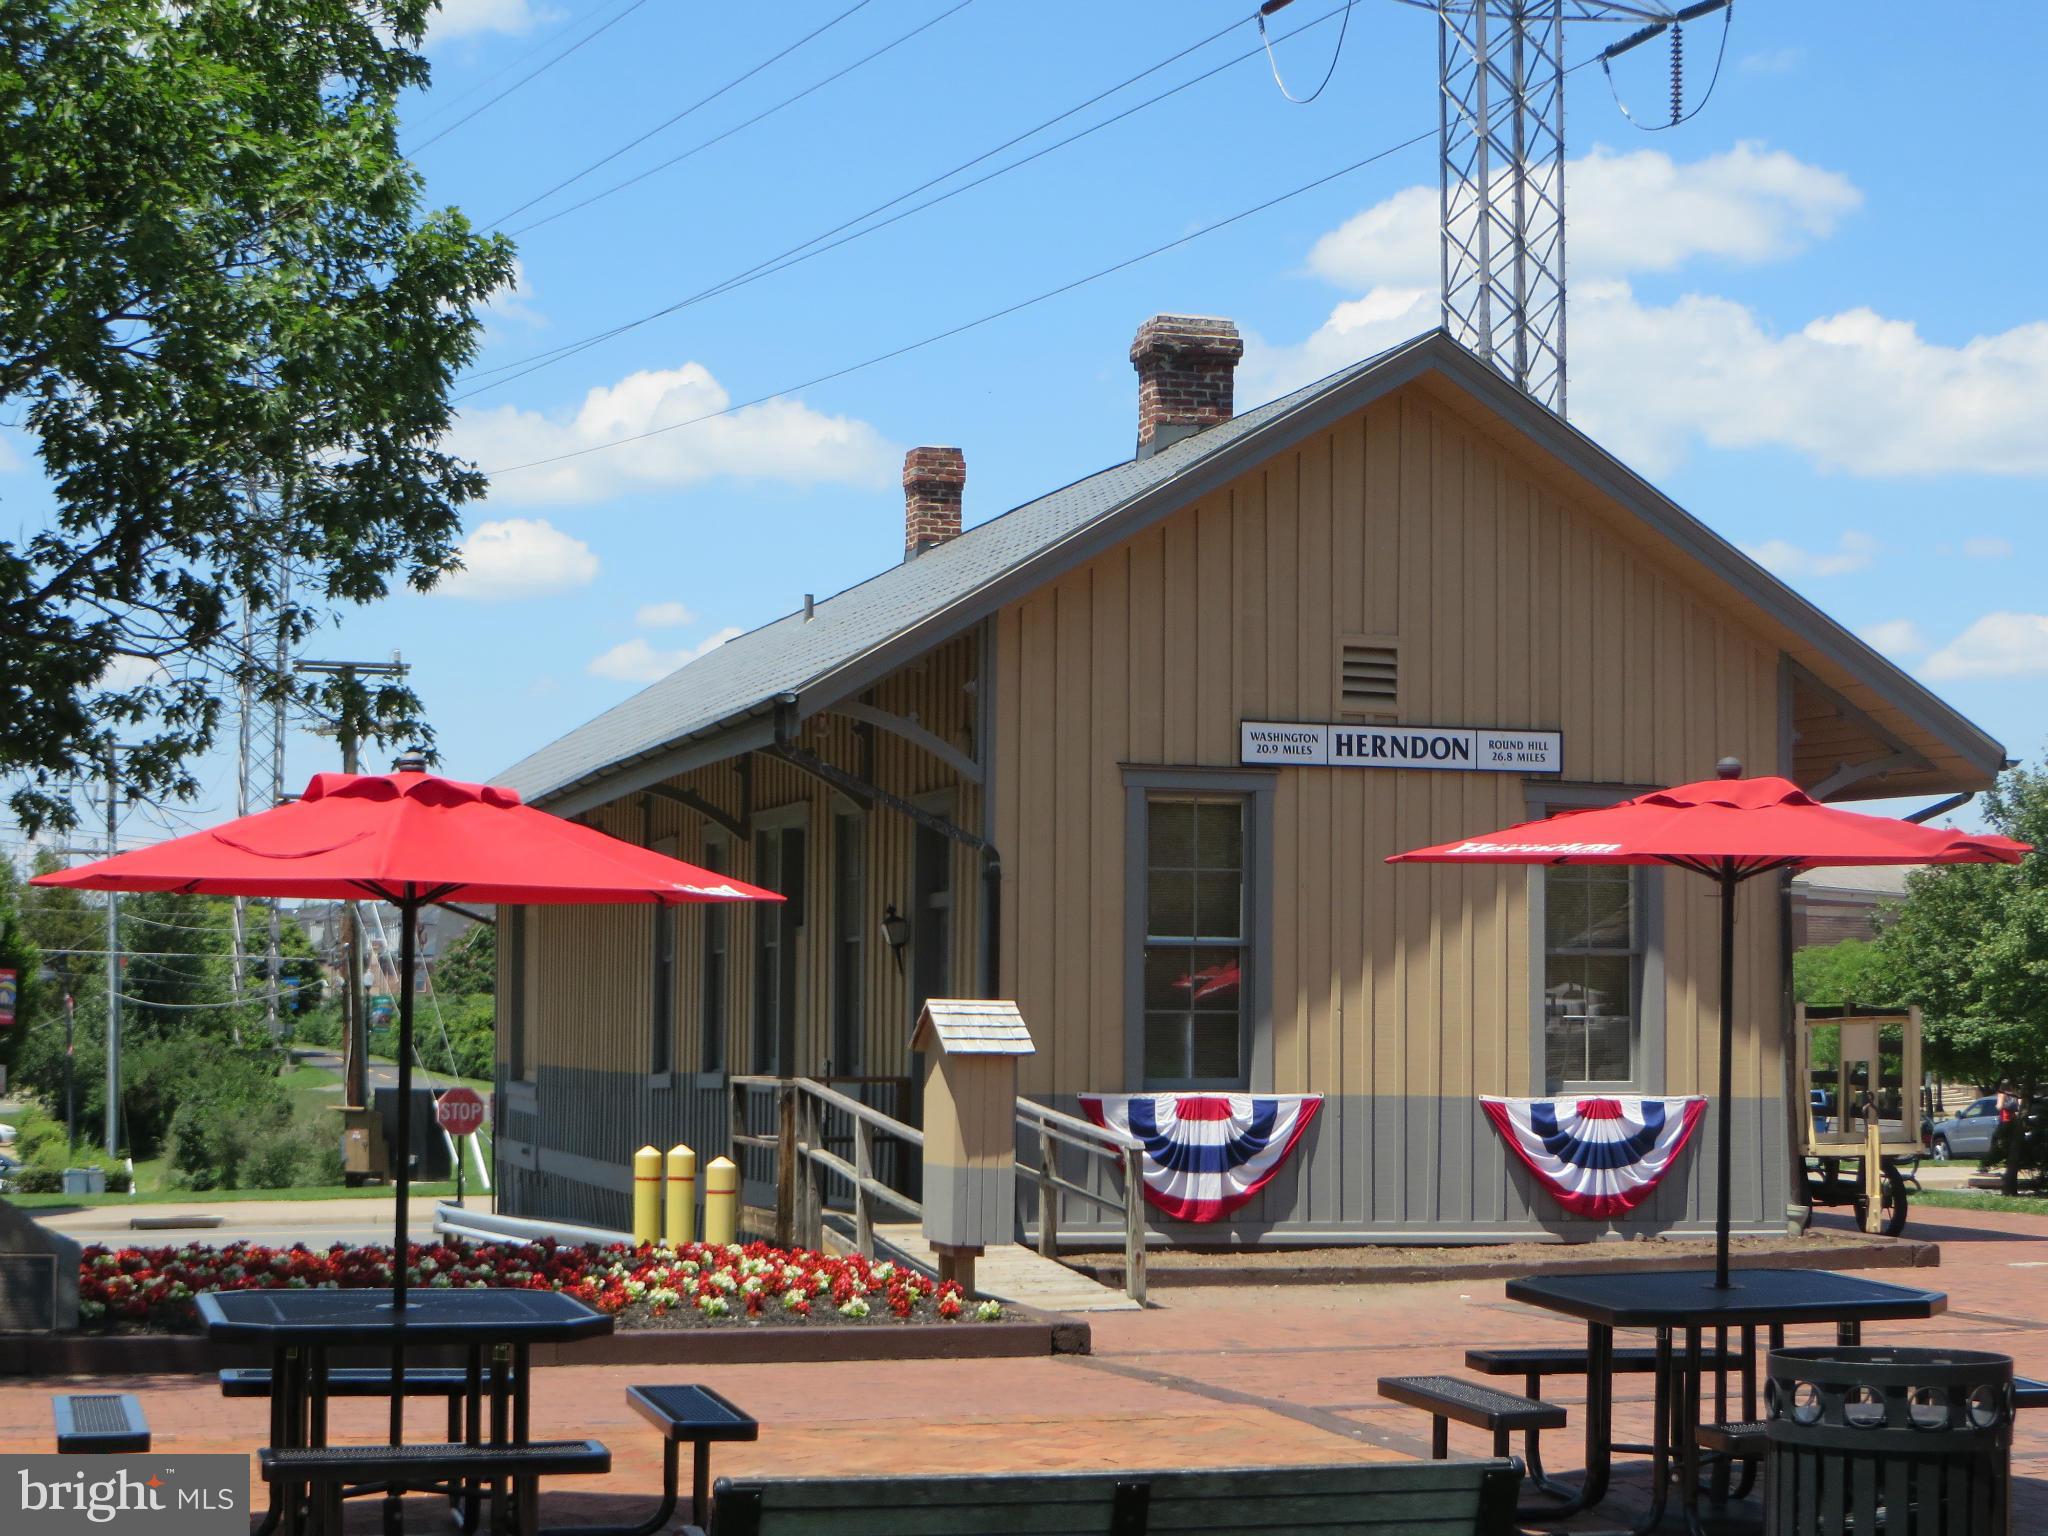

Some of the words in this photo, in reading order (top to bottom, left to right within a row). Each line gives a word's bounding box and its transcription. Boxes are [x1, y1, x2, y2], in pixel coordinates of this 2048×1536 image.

[1250, 731, 1319, 743] WASHINGTON
[1256, 743, 1279, 754] 20.9
[1282, 744, 1313, 755] MILES
[1335, 733, 1470, 760] HERNDON
[1488, 740, 1524, 750] ROUND
[1527, 741, 1549, 751] HILL
[1492, 752, 1513, 762] 26.8
[1516, 752, 1546, 763] MILES
[440, 1102, 482, 1121] STOP
